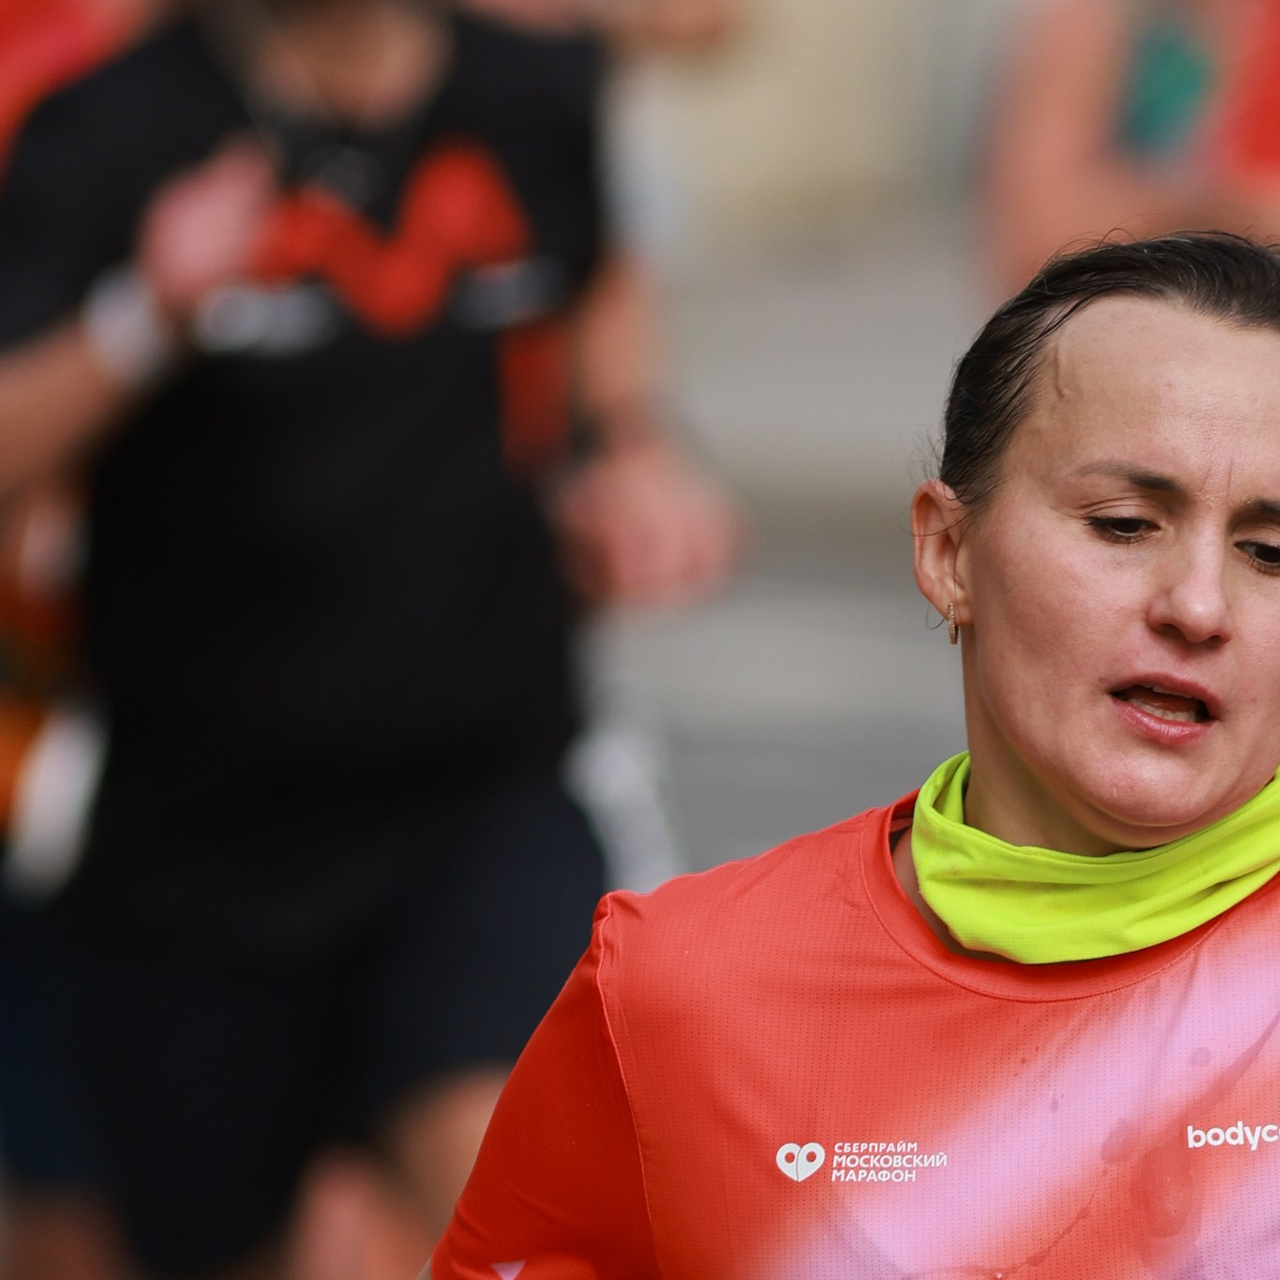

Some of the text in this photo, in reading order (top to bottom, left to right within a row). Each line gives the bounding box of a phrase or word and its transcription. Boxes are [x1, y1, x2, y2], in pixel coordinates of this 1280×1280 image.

[834, 1141, 918, 1154] СБЕРПРАЙМ
[832, 1152, 948, 1169] МОСКОВСКИЙ
[831, 1168, 916, 1183] МАРАФОН
